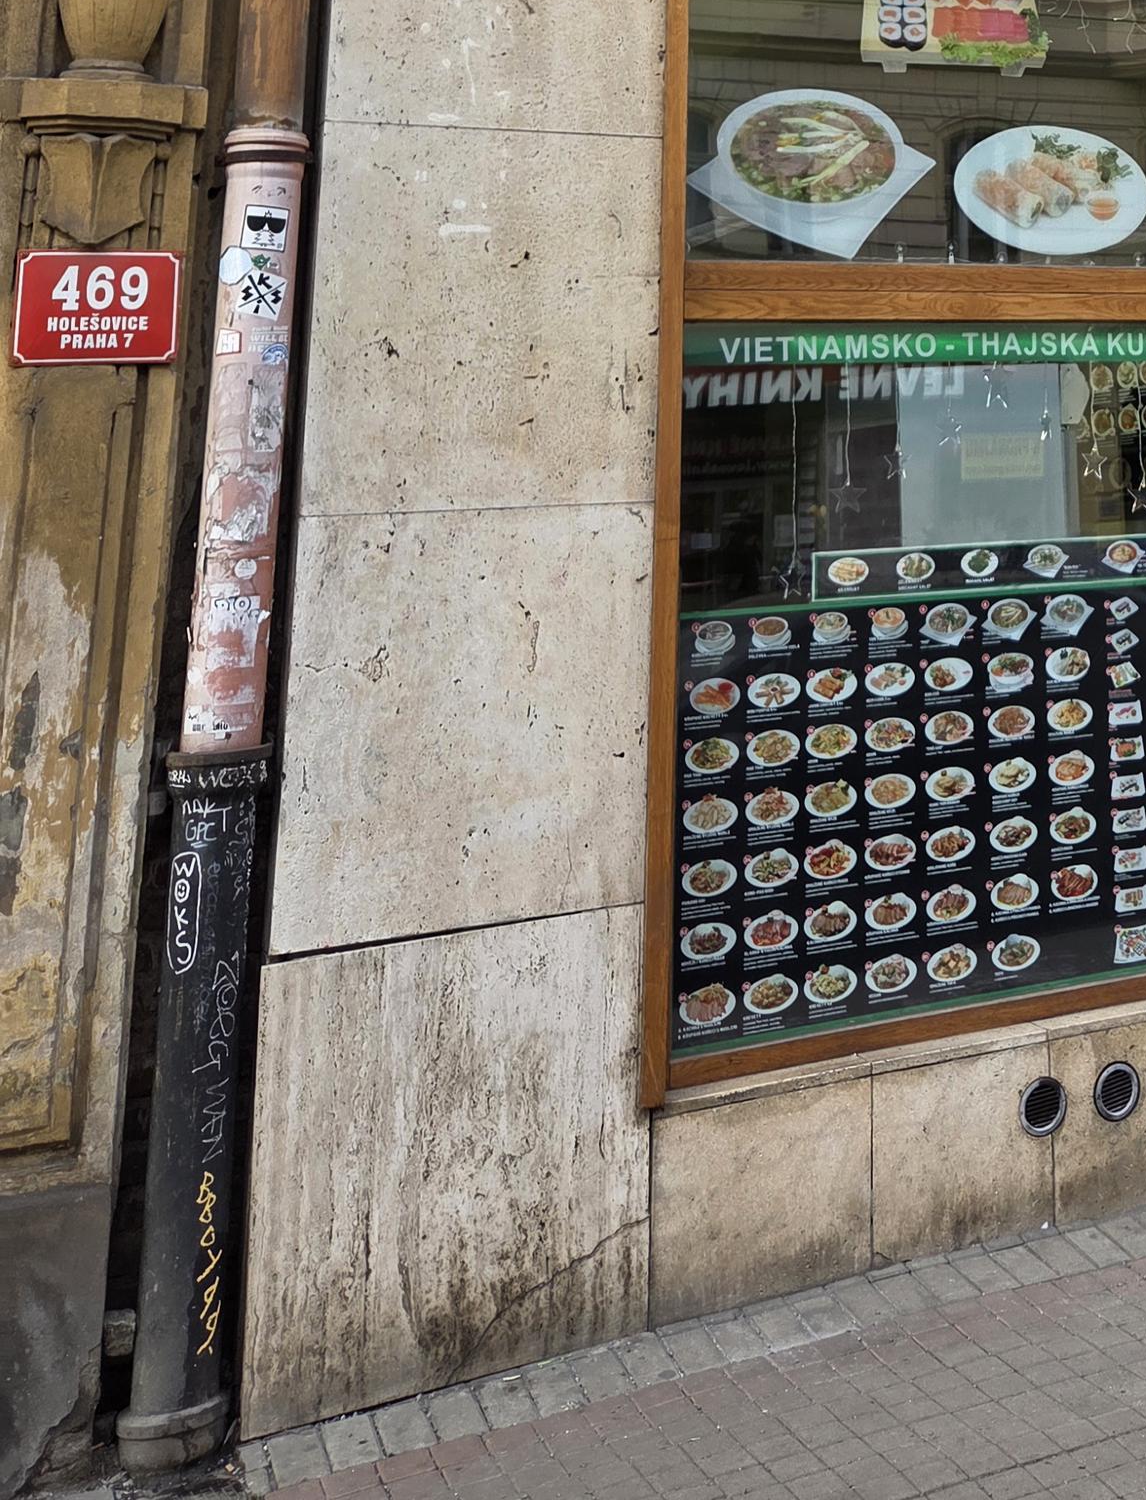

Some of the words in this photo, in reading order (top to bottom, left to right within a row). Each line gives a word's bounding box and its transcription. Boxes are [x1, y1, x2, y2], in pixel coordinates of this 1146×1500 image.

[51, 265, 149, 311] 469
[46, 312, 149, 333] HOLEŠOVICE
[60, 334, 119, 350] PRAHA
[122, 332, 134, 350] 7
[719, 332, 938, 364] VIETNAMSKO
[961, 326, 1101, 358] THAJSKÁ
